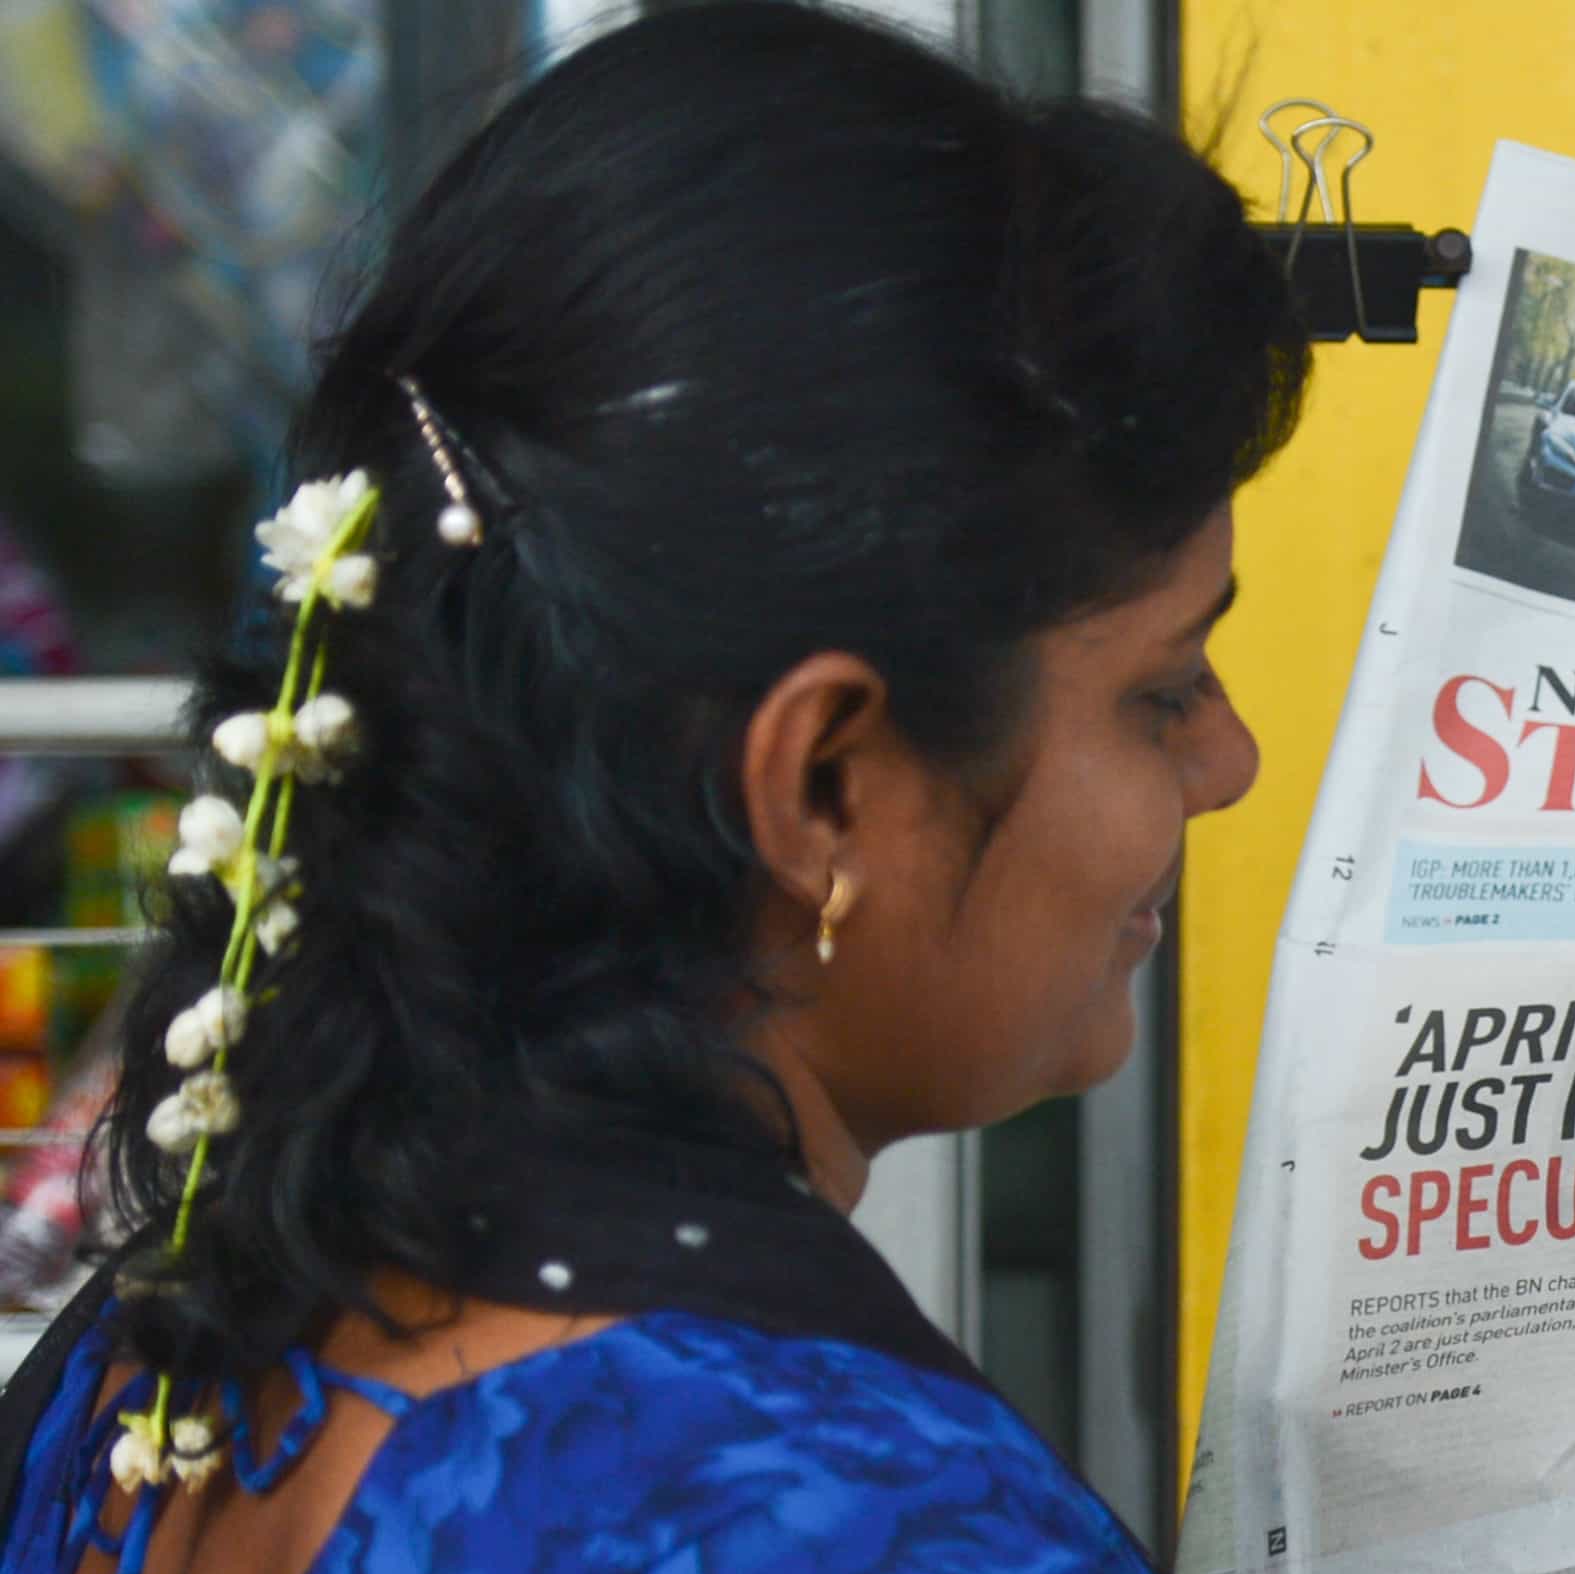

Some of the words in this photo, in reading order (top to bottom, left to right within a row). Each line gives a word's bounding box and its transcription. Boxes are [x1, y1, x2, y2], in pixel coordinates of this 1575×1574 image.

[1450, 859, 1503, 881] MORE
[1507, 858, 1557, 880] THAN
[1454, 912, 1486, 926] PAGE
[1488, 912, 1500, 925] 2
[1358, 1072, 1553, 1162] JUST
[1350, 1289, 1440, 1318] REPORTS
[1445, 1286, 1479, 1307] that
[1482, 1280, 1510, 1301] the
[1515, 1274, 1543, 1296] BN
[1348, 1322, 1375, 1341] the
[1380, 1308, 1466, 1339] coalition's
[1344, 1342, 1386, 1364] April
[1403, 1336, 1432, 1354] are
[1434, 1330, 1468, 1353] just
[1339, 1353, 1422, 1385] Minister's
[1425, 1349, 1480, 1373] Office.
[1345, 1394, 1402, 1418] REPORT
[1405, 1392, 1427, 1406] ON
[1430, 1384, 1470, 1403] PAGE
